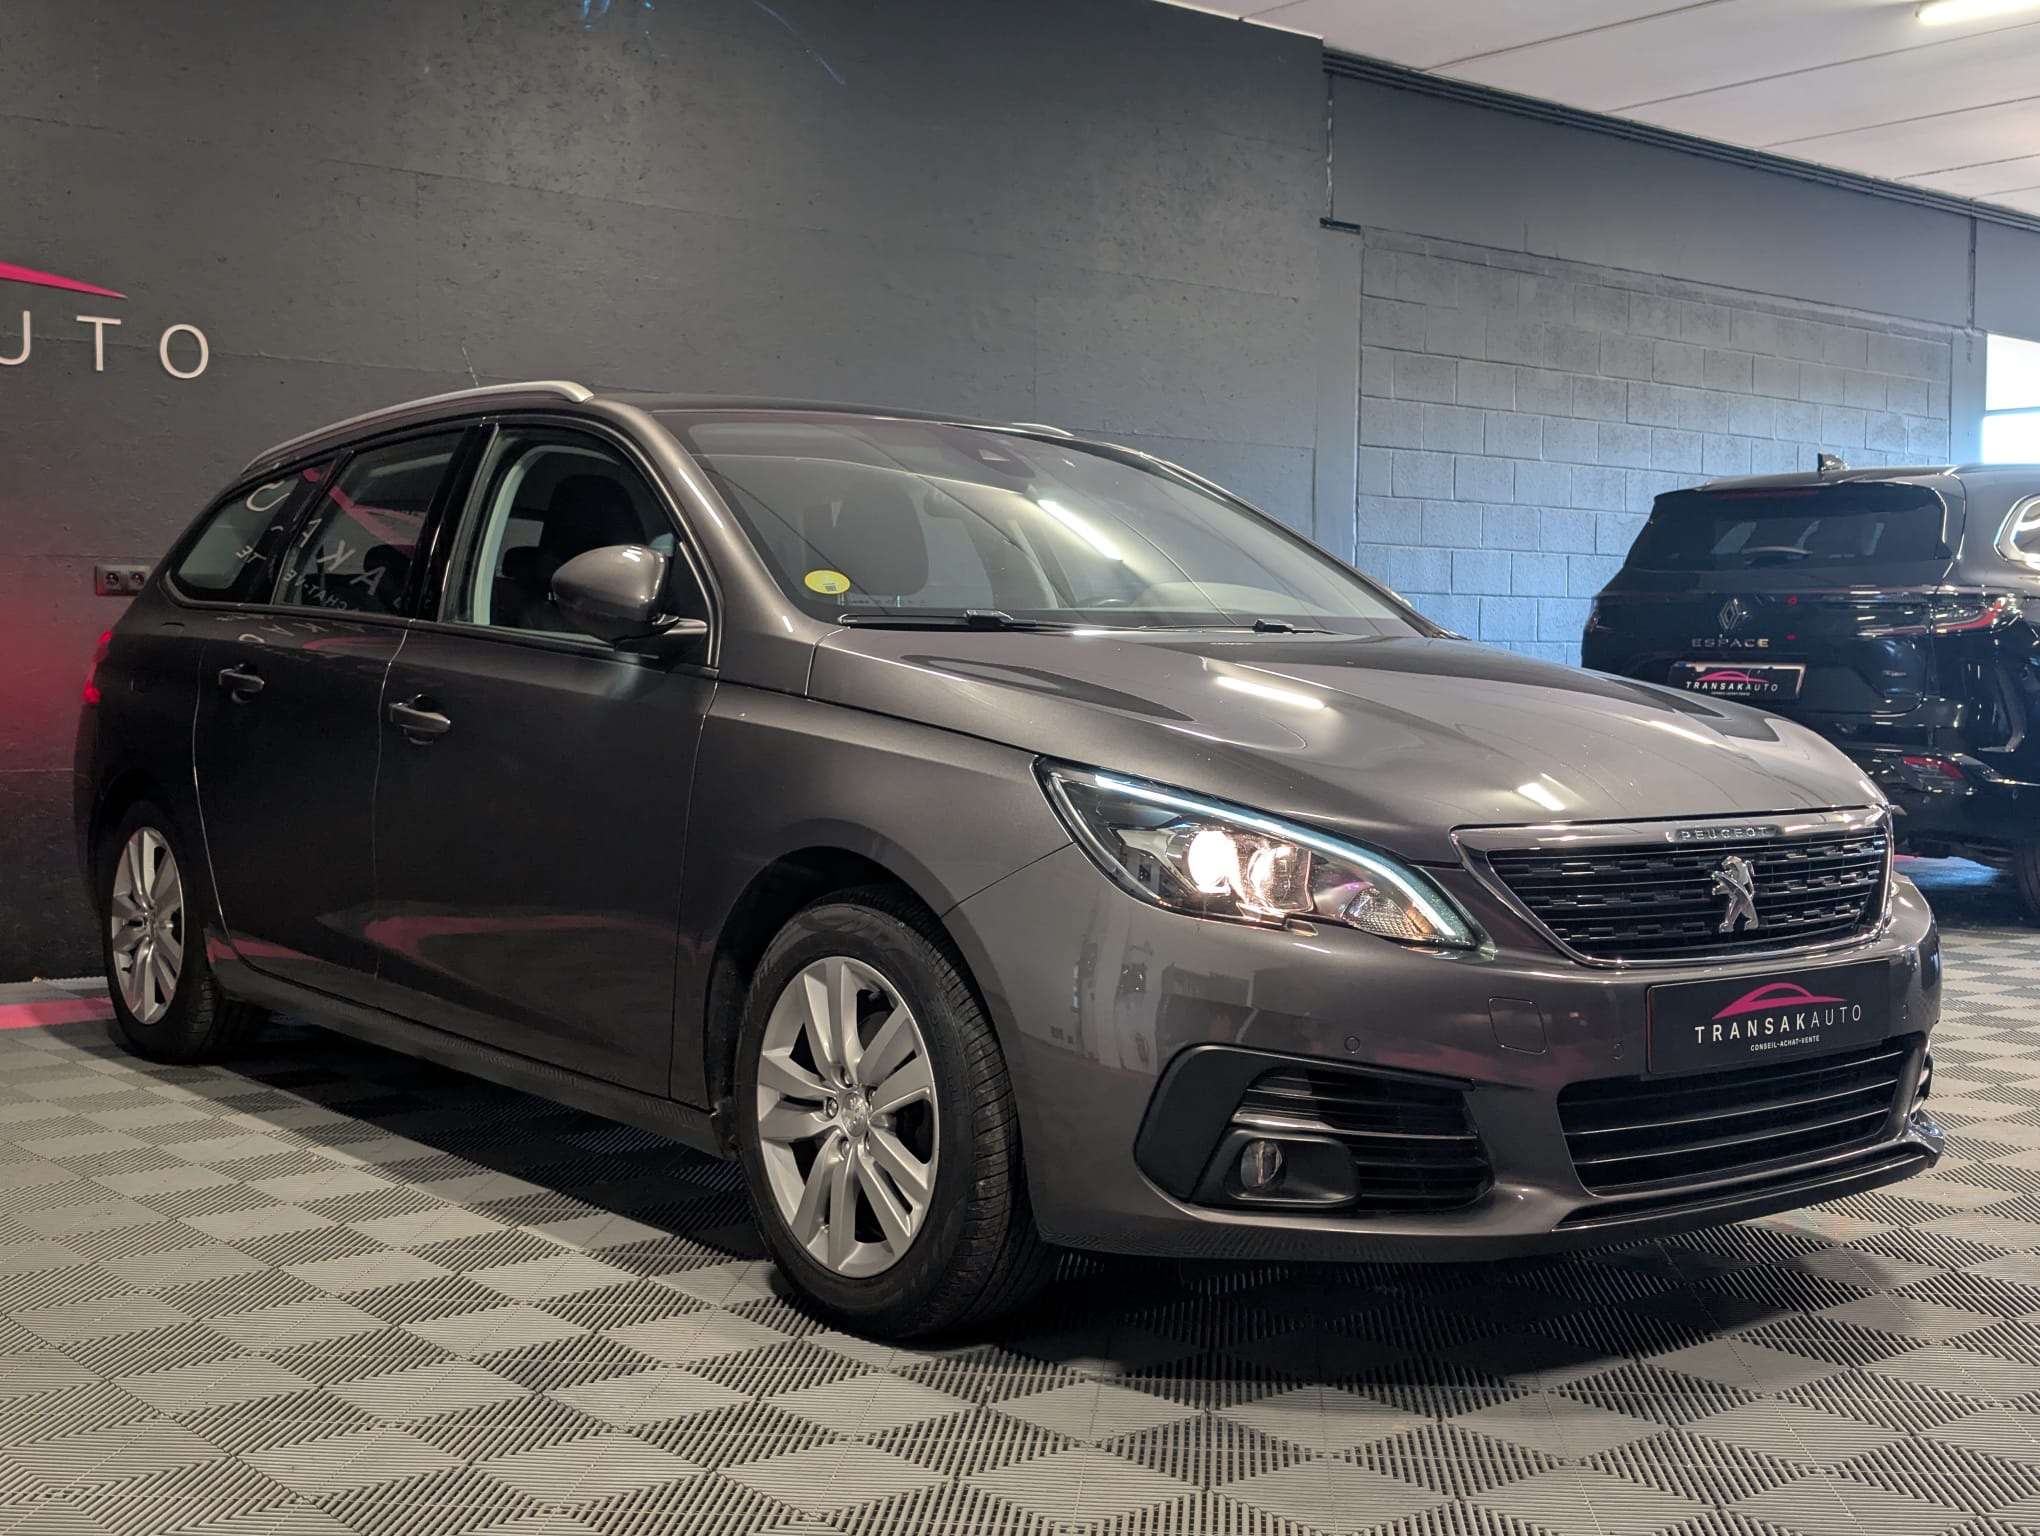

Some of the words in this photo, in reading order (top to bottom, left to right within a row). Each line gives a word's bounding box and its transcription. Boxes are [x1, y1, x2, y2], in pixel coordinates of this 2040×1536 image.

[1691, 638, 1769, 648] ESPACE
[1685, 681, 1779, 692] TRANSAKAUTO
[1681, 826, 1767, 840] PEUGEOT
[1694, 1004, 1862, 1044] TRANSAKAUTO
